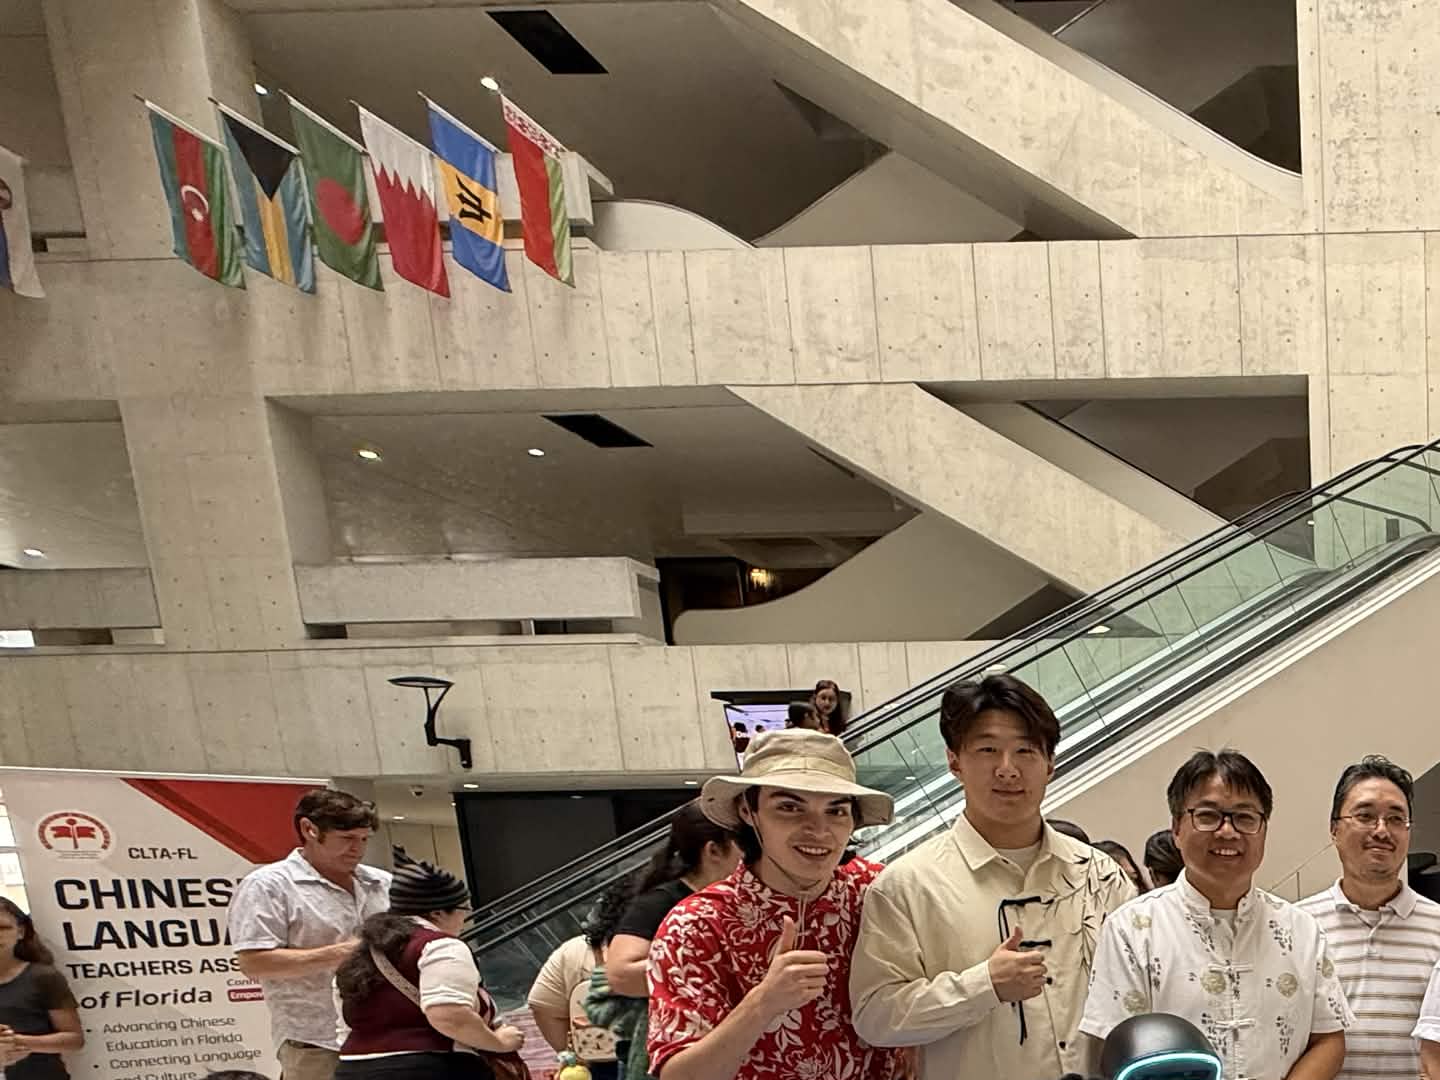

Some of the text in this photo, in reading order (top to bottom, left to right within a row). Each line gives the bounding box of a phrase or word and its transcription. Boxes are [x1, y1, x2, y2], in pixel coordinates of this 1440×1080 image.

[128, 847, 198, 860] CLTA-FL
[54, 878, 246, 910] CHINES
[62, 918, 232, 951] LANGU
[65, 959, 193, 979] TEACHERS
[80, 987, 212, 1009] of Florida
[103, 1017, 236, 1034] Advancing Chinese
[106, 1032, 243, 1052] Education in Florida
[110, 1048, 262, 1069] Connecting Language
